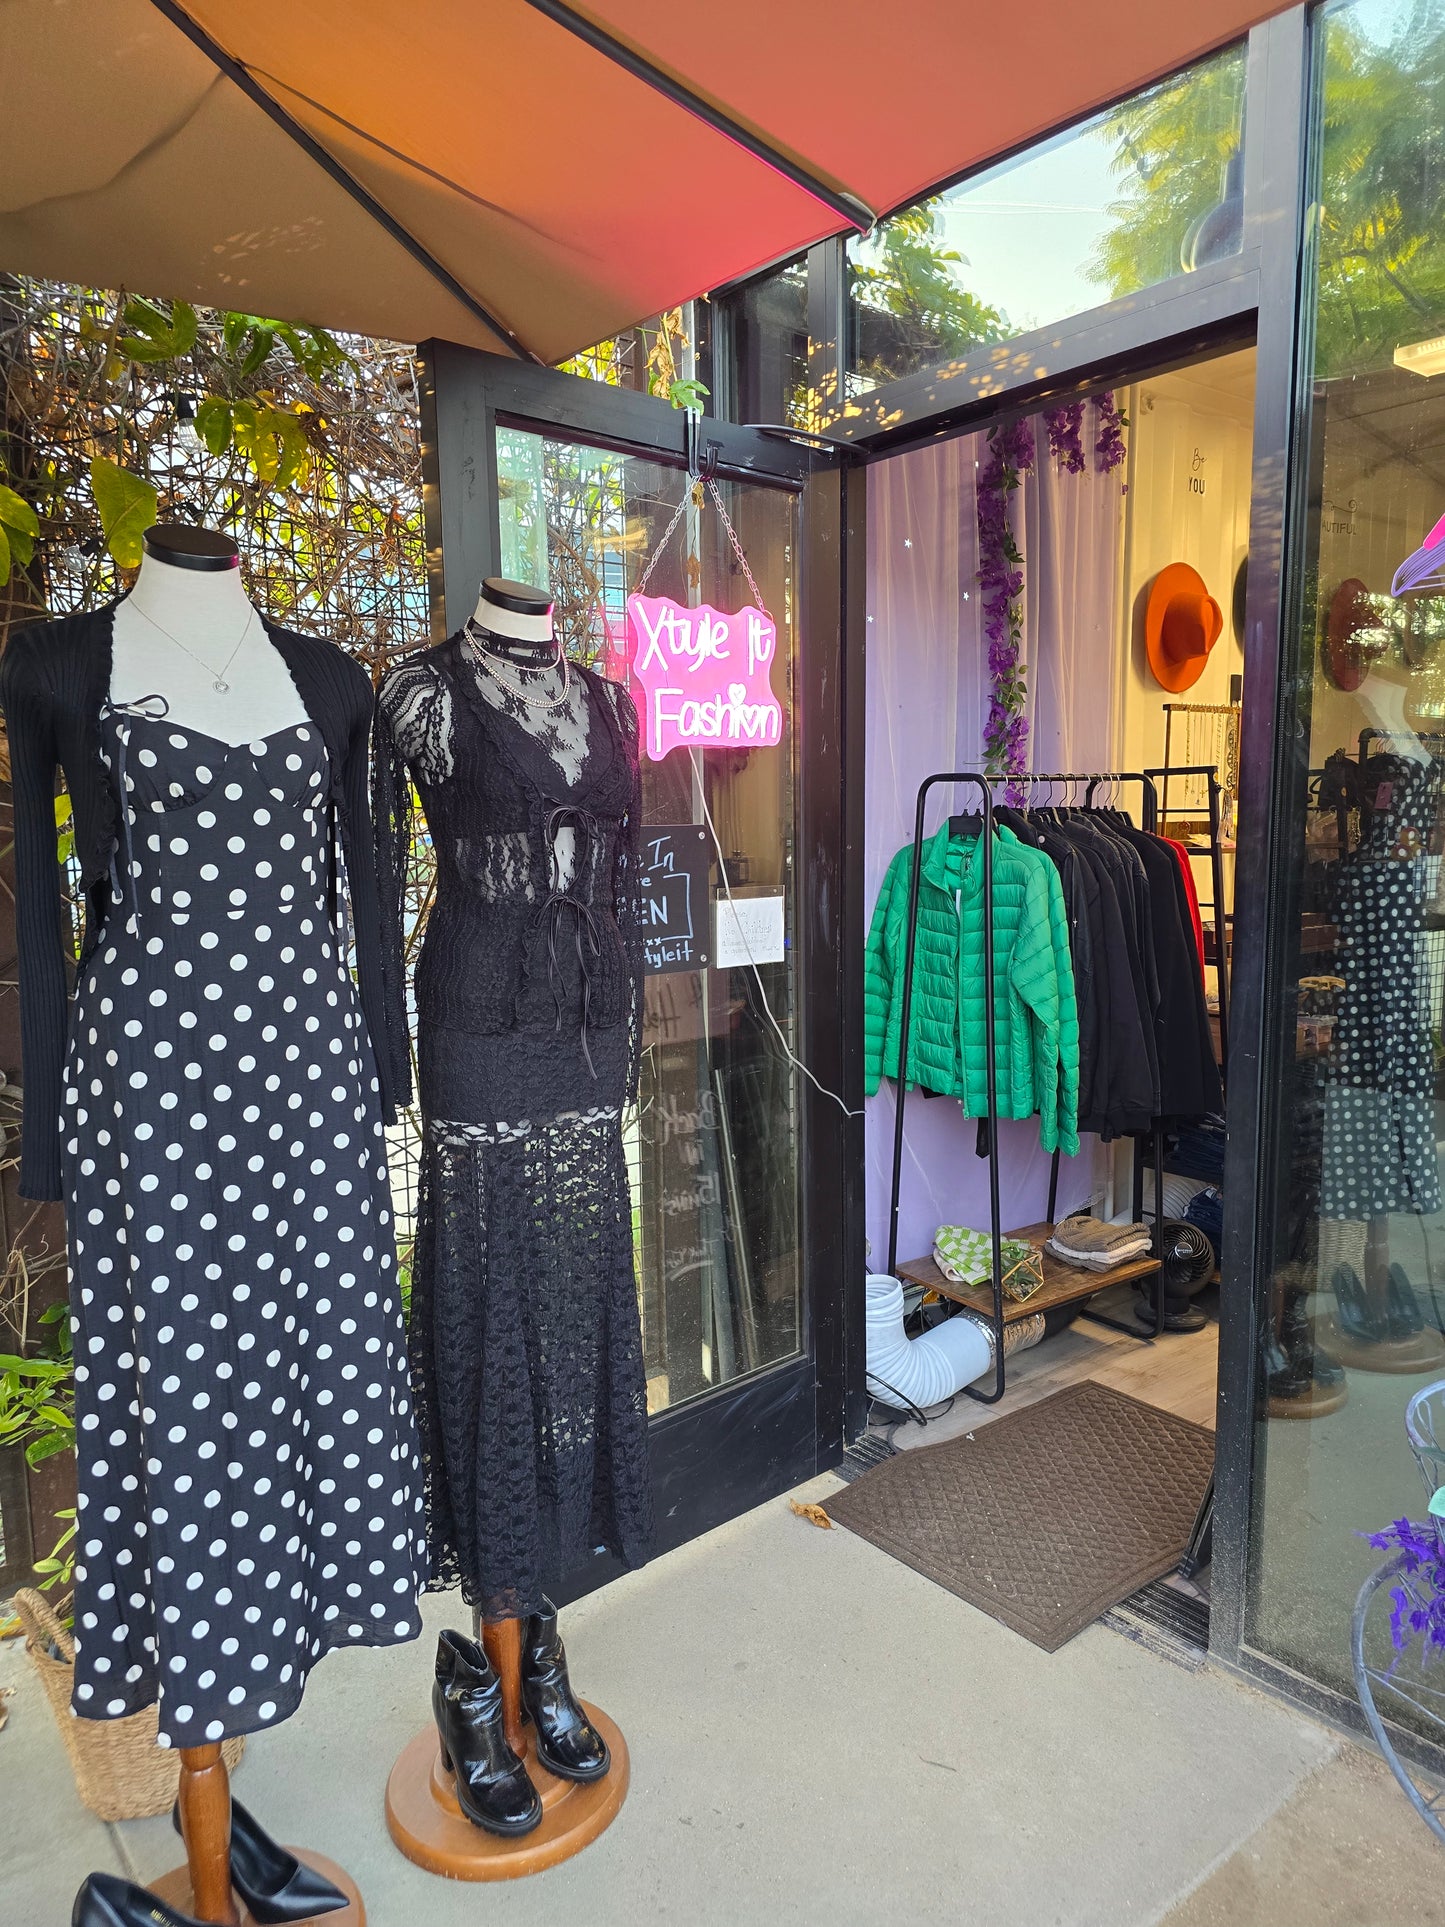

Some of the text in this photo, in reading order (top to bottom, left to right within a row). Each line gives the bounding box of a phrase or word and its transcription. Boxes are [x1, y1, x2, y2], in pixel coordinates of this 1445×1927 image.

[1192, 447, 1207, 471] Be
[1188, 473, 1205, 494] YOU
[1322, 519, 1357, 535] AUTIFUL
[635, 601, 772, 676] Xtyle It
[655, 683, 778, 752] Fashion
[647, 836, 674, 871] In
[644, 940, 694, 968] tyleit
